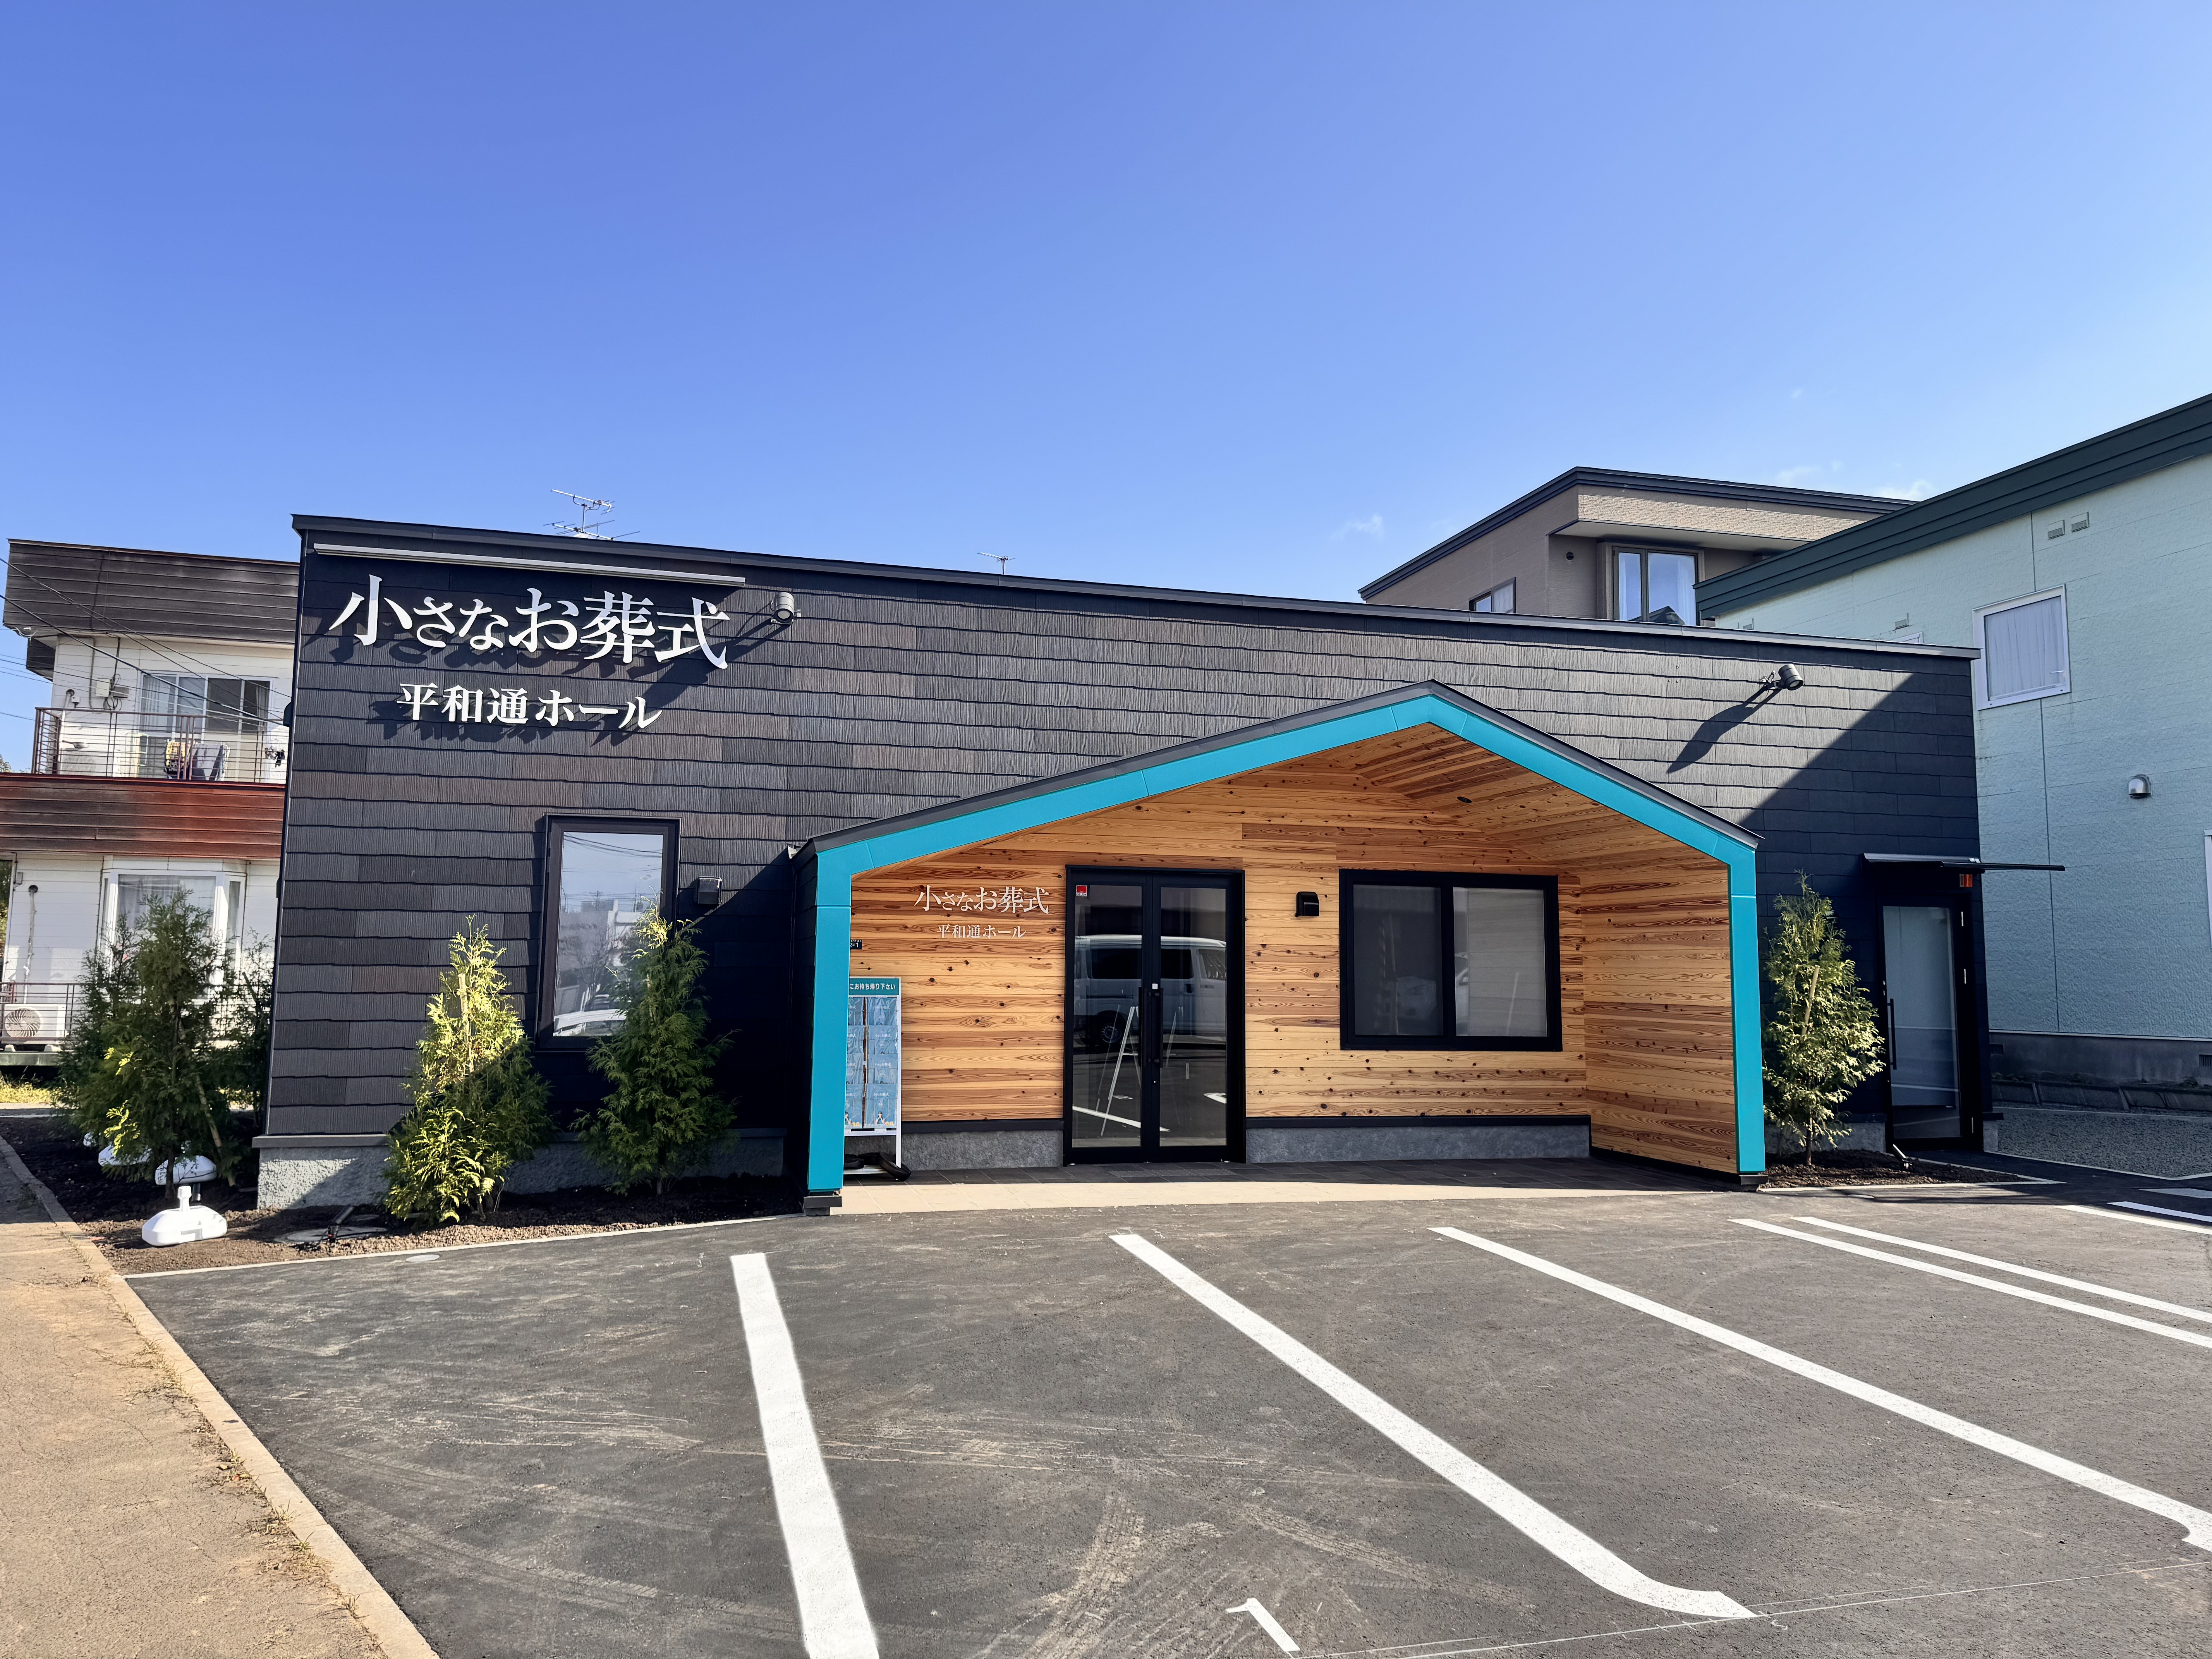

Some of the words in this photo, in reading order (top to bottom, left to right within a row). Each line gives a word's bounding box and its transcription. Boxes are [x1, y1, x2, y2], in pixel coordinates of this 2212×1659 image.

[328, 574, 730, 670] 小さなお葬式
[396, 682, 663, 730] 平和通ホール
[914, 884, 1049, 914] 小さなお葬式
[936, 924, 1027, 939] 平和通ホール
